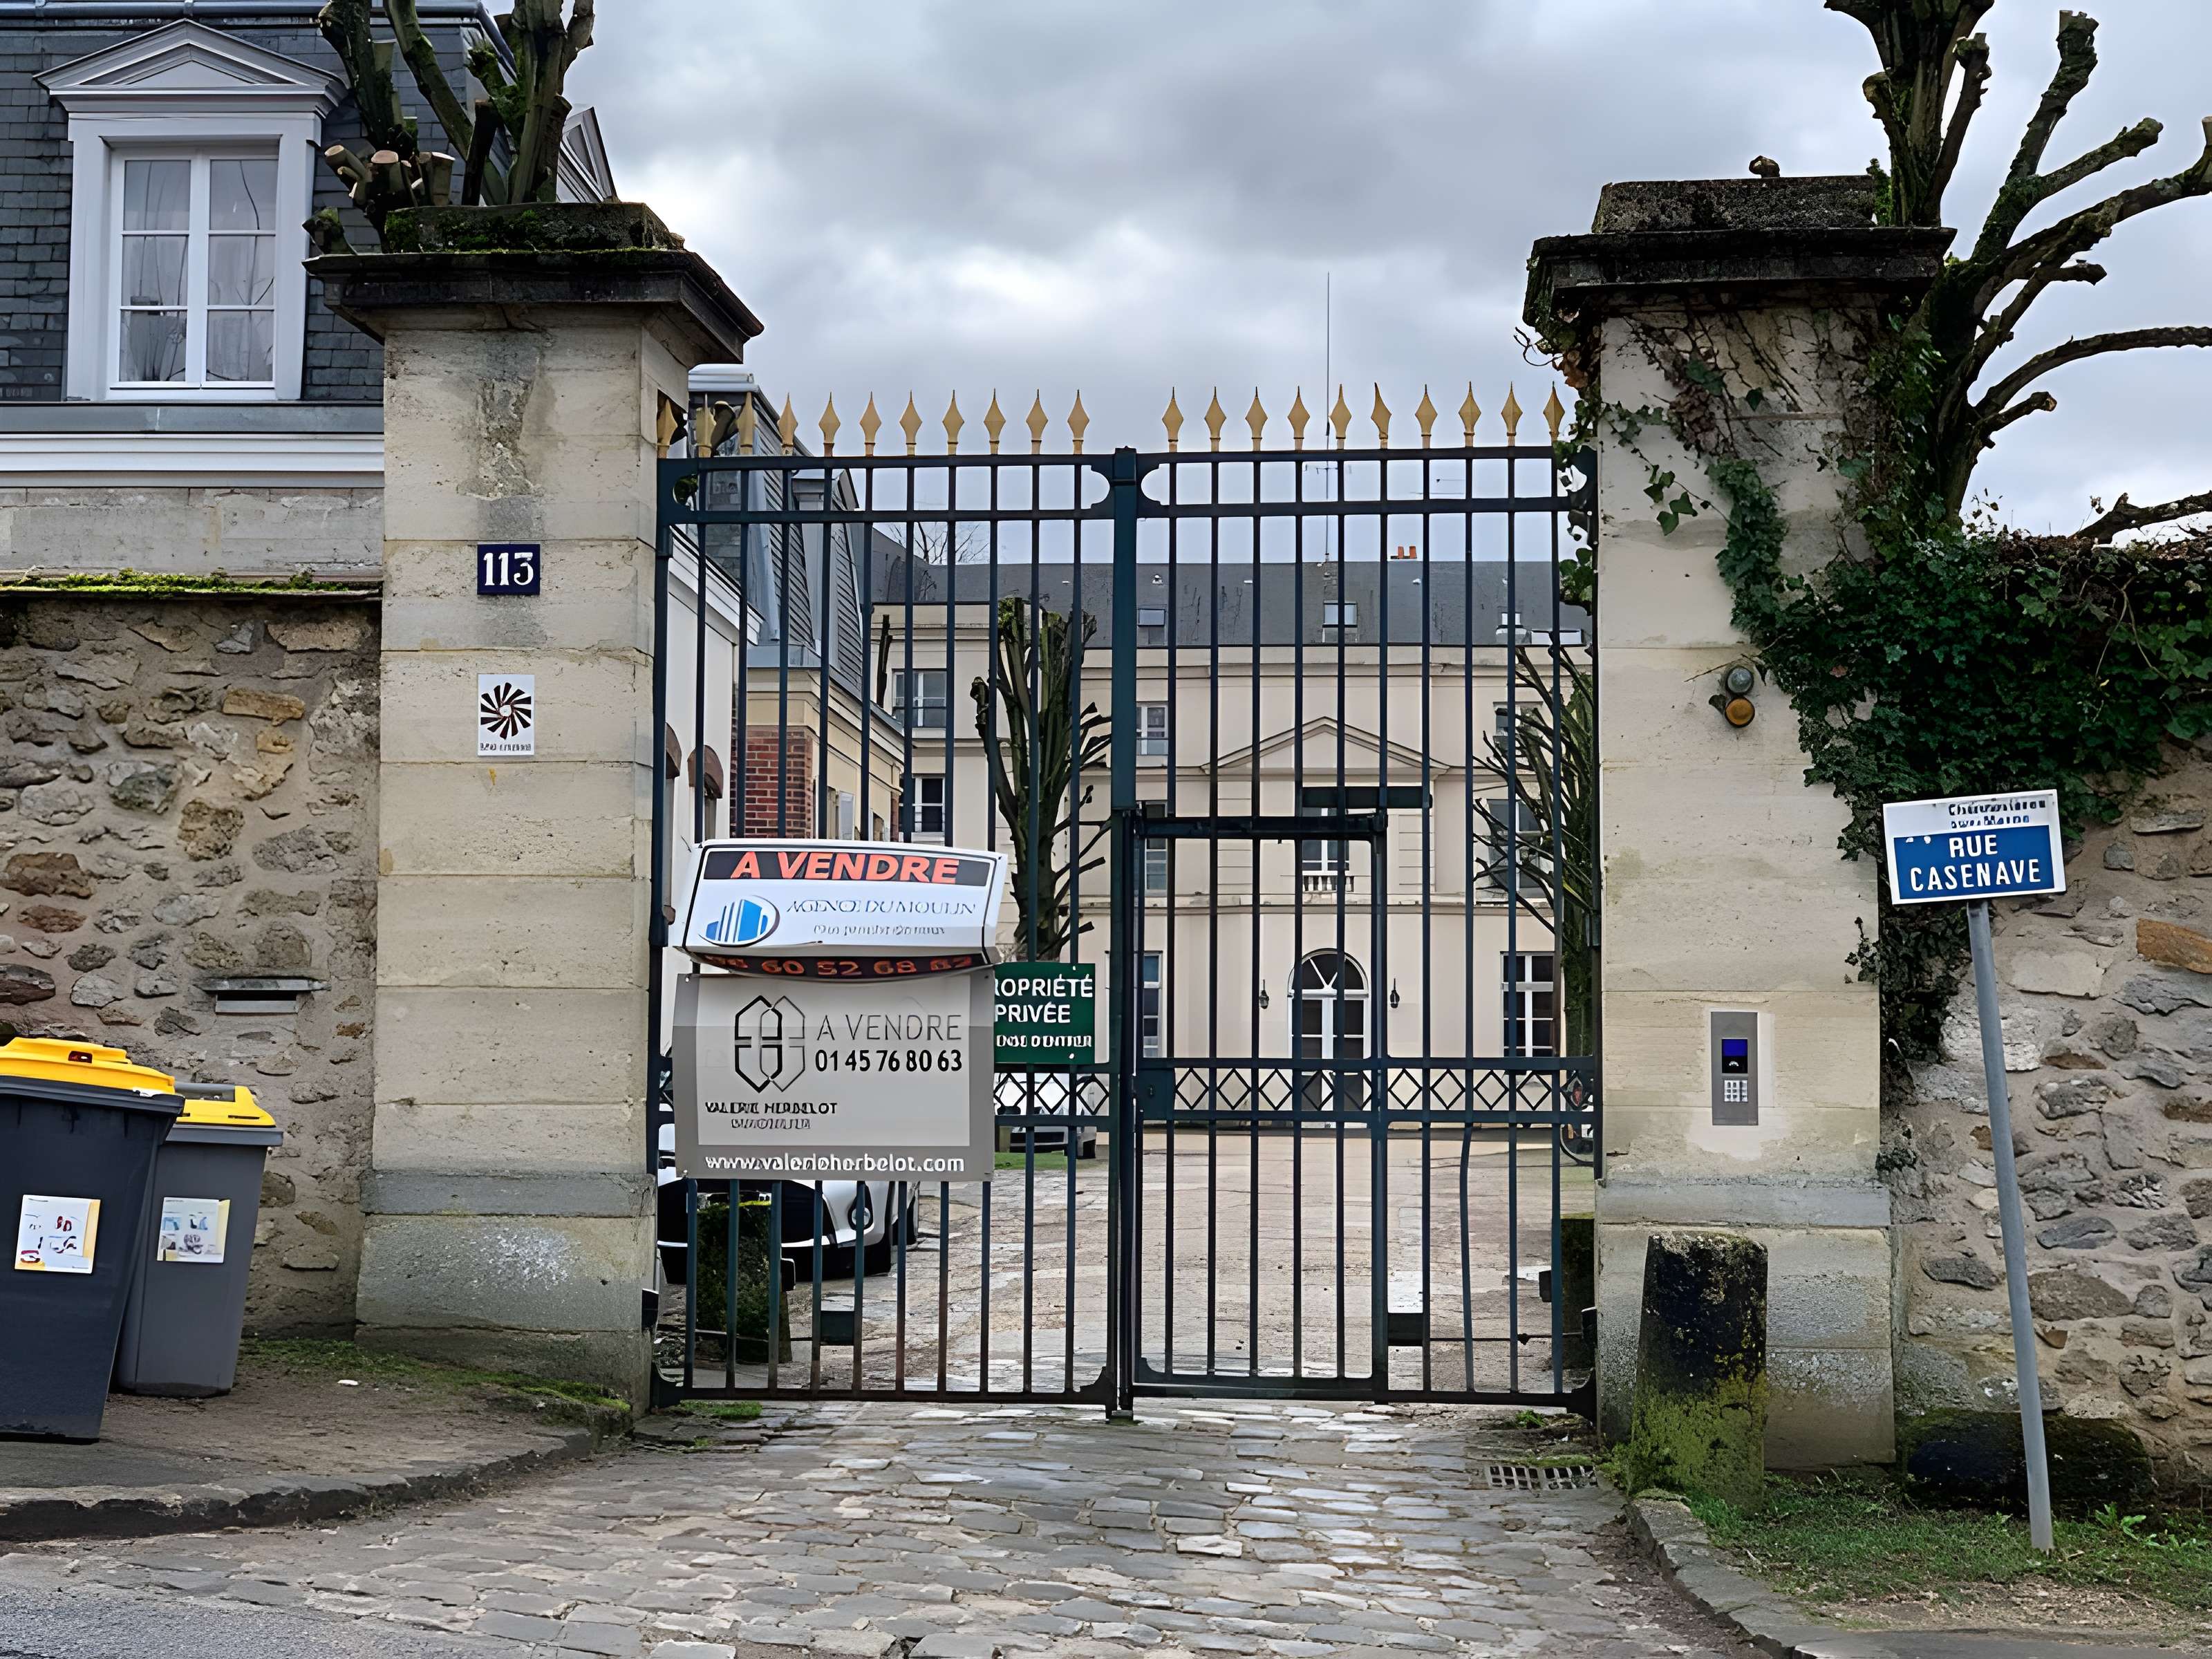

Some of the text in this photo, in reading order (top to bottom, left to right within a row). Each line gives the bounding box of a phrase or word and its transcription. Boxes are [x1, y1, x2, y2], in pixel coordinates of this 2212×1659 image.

[483, 552, 534, 586] 113
[1949, 834, 1998, 859] RUE
[729, 851, 960, 885] A VENDRE
[1910, 859, 2041, 892] CASENAVE
[995, 973, 1093, 997] OPRIÉTÉ
[995, 1002, 1071, 1023] PRIVÉE
[816, 1014, 962, 1041] A VENDRE
[815, 1049, 962, 1072] 01 45 76 80 63
